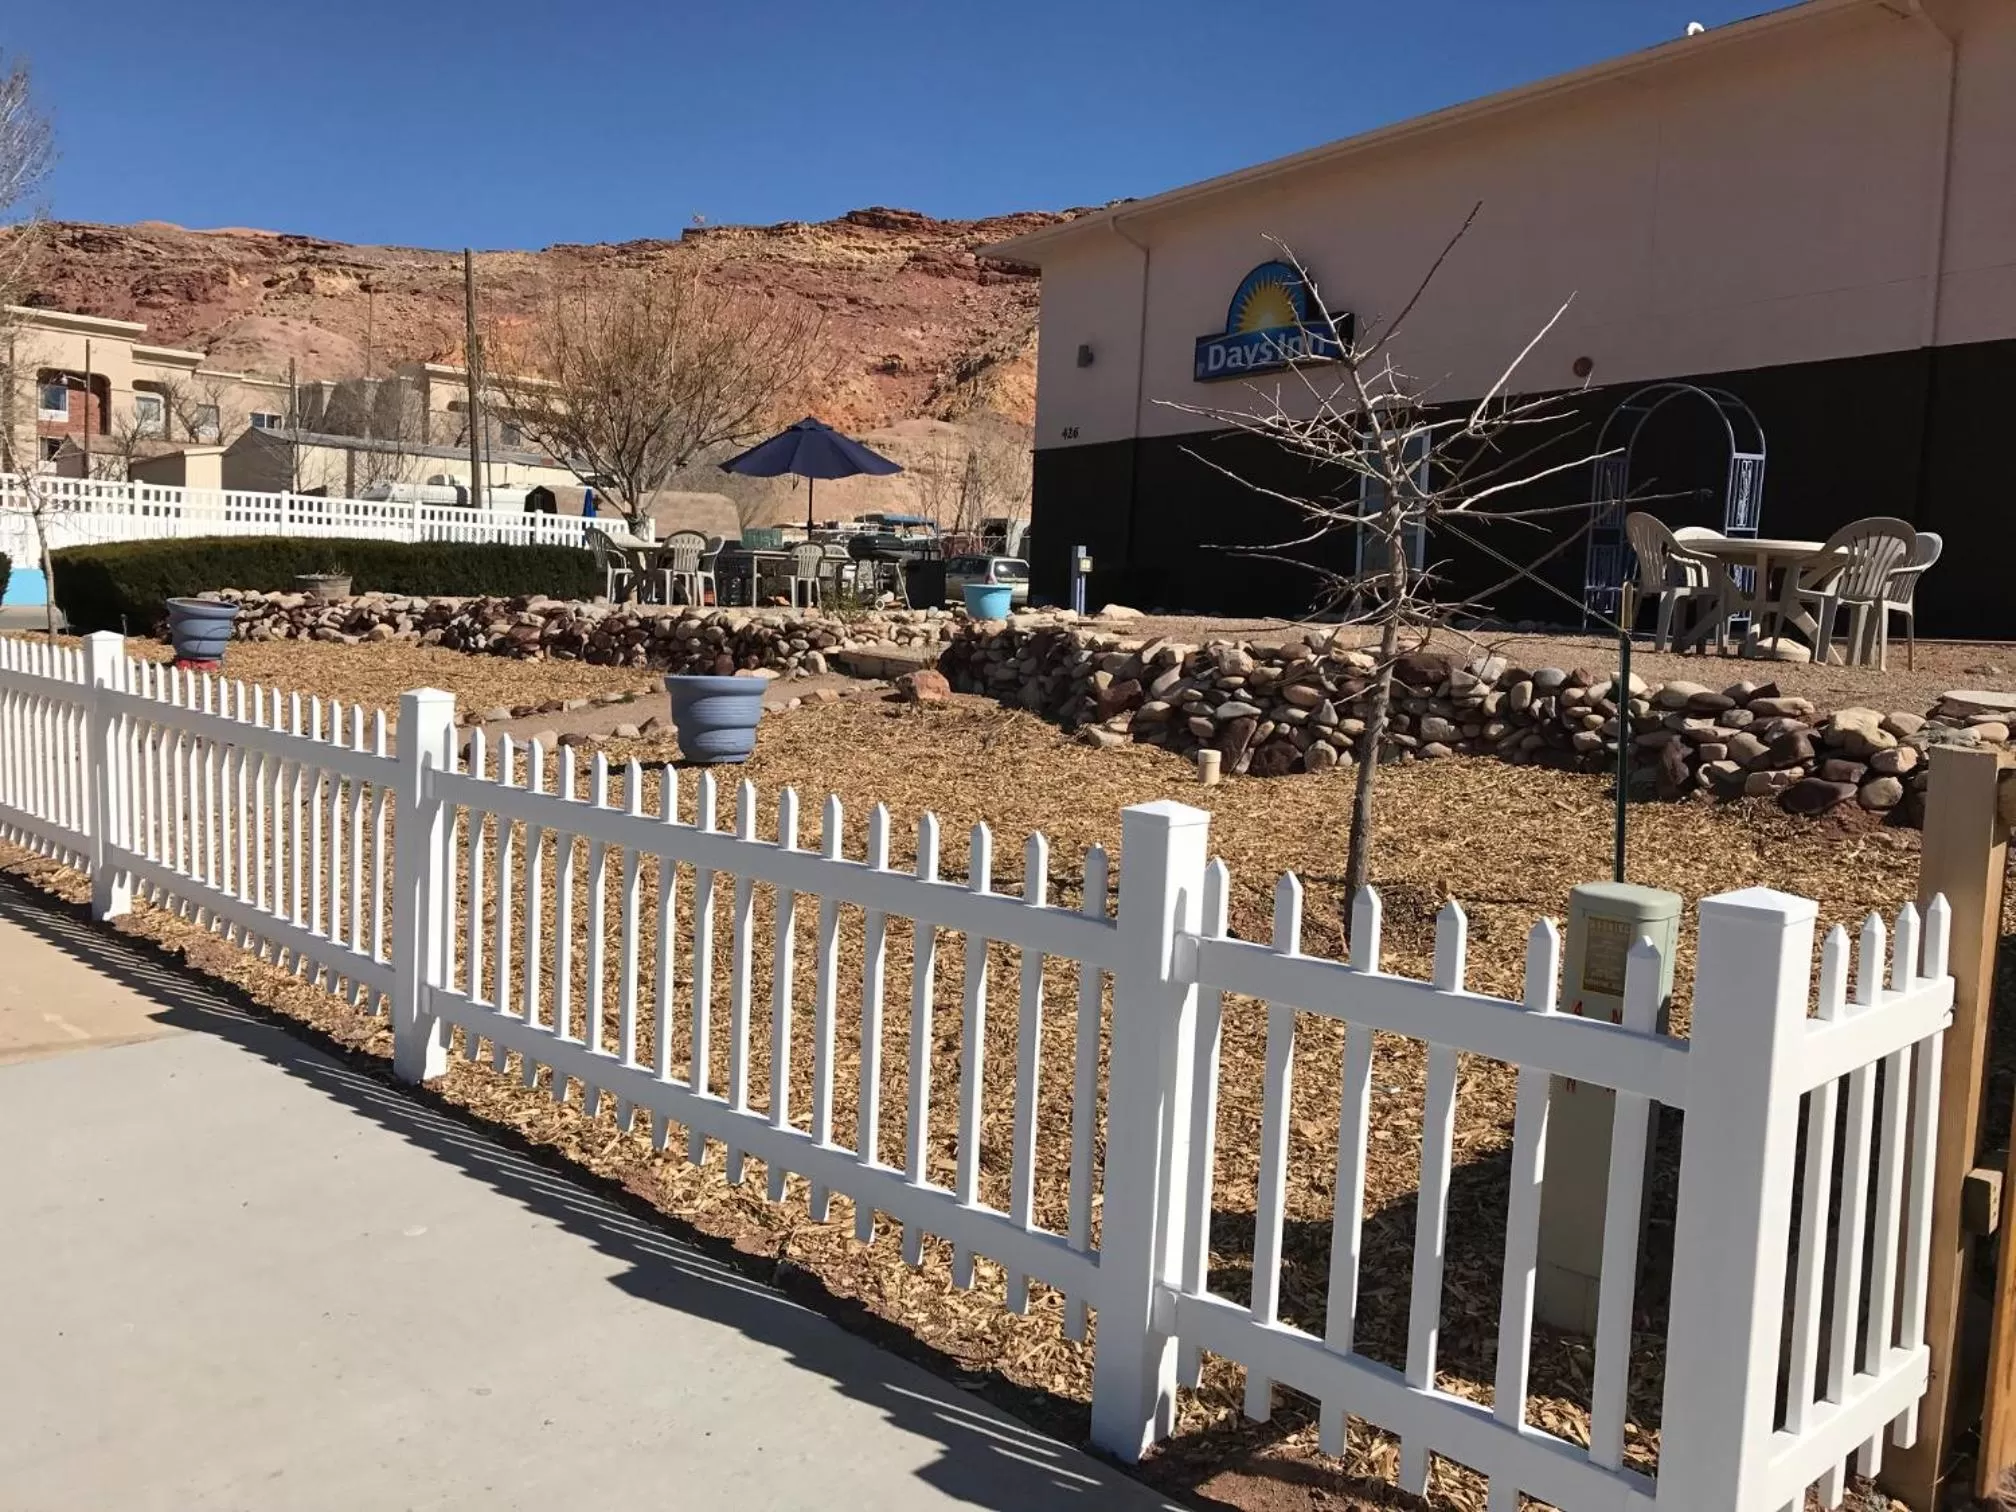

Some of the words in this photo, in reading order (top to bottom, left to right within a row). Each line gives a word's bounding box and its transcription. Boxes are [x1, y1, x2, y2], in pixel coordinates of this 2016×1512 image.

[1207, 341, 1272, 371] Days
[1275, 333, 1325, 360] Inn
[1061, 426, 1080, 440] 426
